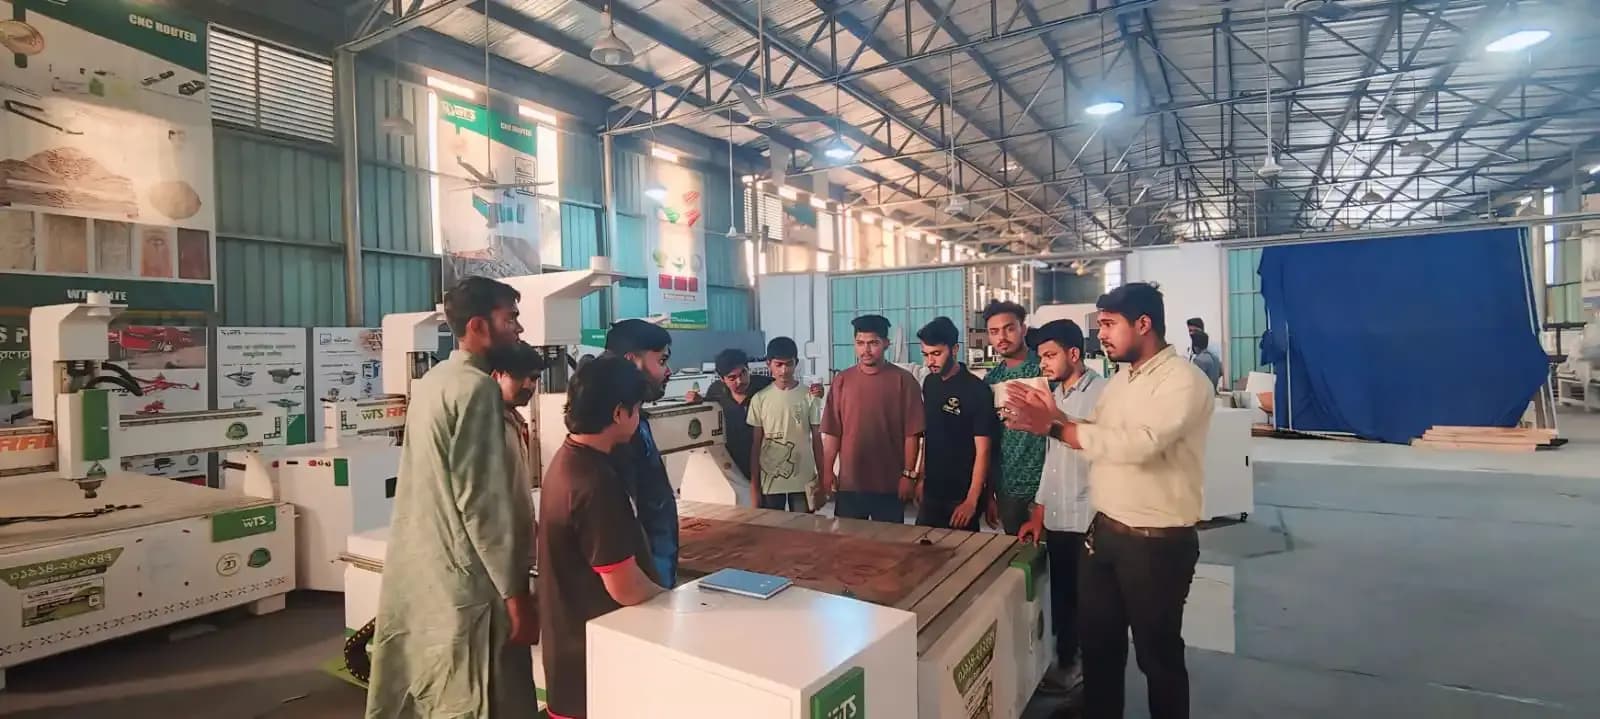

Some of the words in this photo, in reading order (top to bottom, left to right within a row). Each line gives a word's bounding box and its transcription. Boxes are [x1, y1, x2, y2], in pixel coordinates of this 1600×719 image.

[129, 13, 153, 29] CNC
[155, 21, 198, 42] ROUTER
[242, 515, 267, 528] WTS
